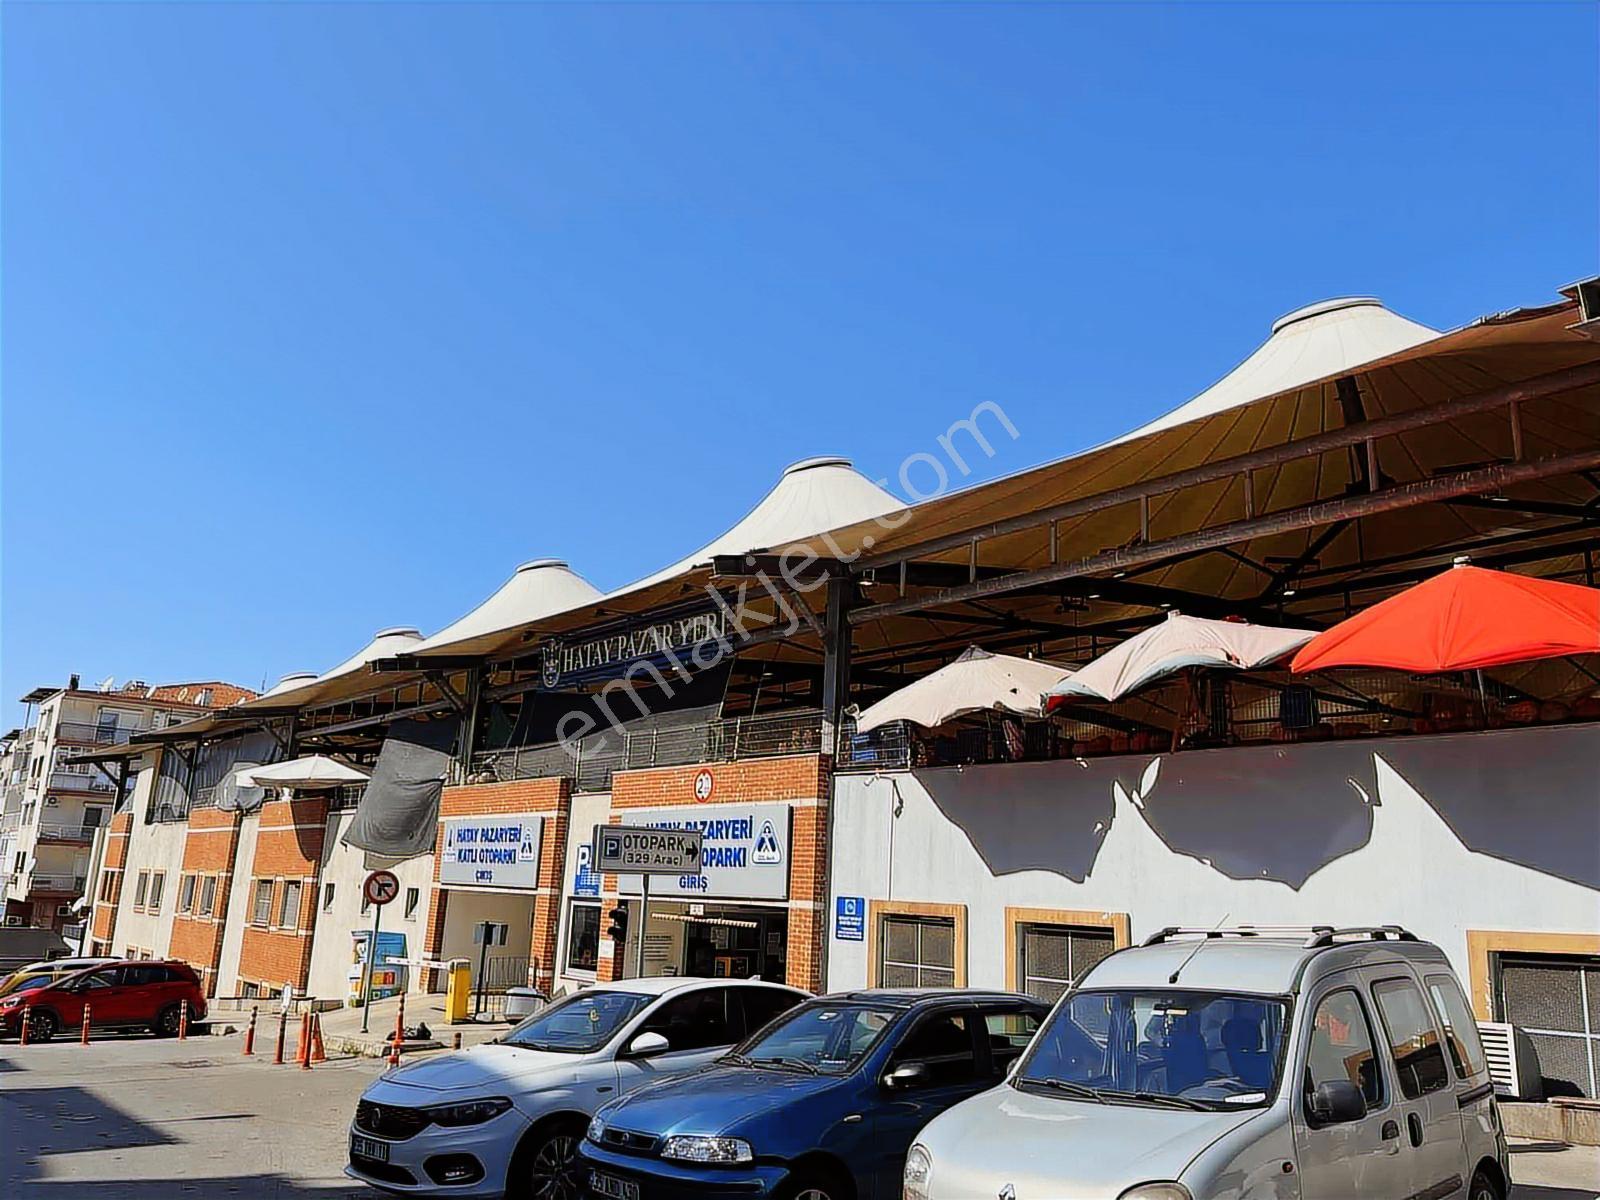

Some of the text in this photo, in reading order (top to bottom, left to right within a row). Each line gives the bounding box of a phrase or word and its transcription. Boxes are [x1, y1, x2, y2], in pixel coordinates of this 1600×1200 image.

[563, 639, 614, 673] HATAY
[457, 823, 522, 842] HATAY PAZARYERİ
[606, 835, 686, 855] P OTOPARK
[458, 848, 516, 864] KATLI OTOPARKI
[623, 852, 650, 864] (329
[701, 847, 746, 867] OPARKI
[679, 874, 708, 892] GİRİŞ
